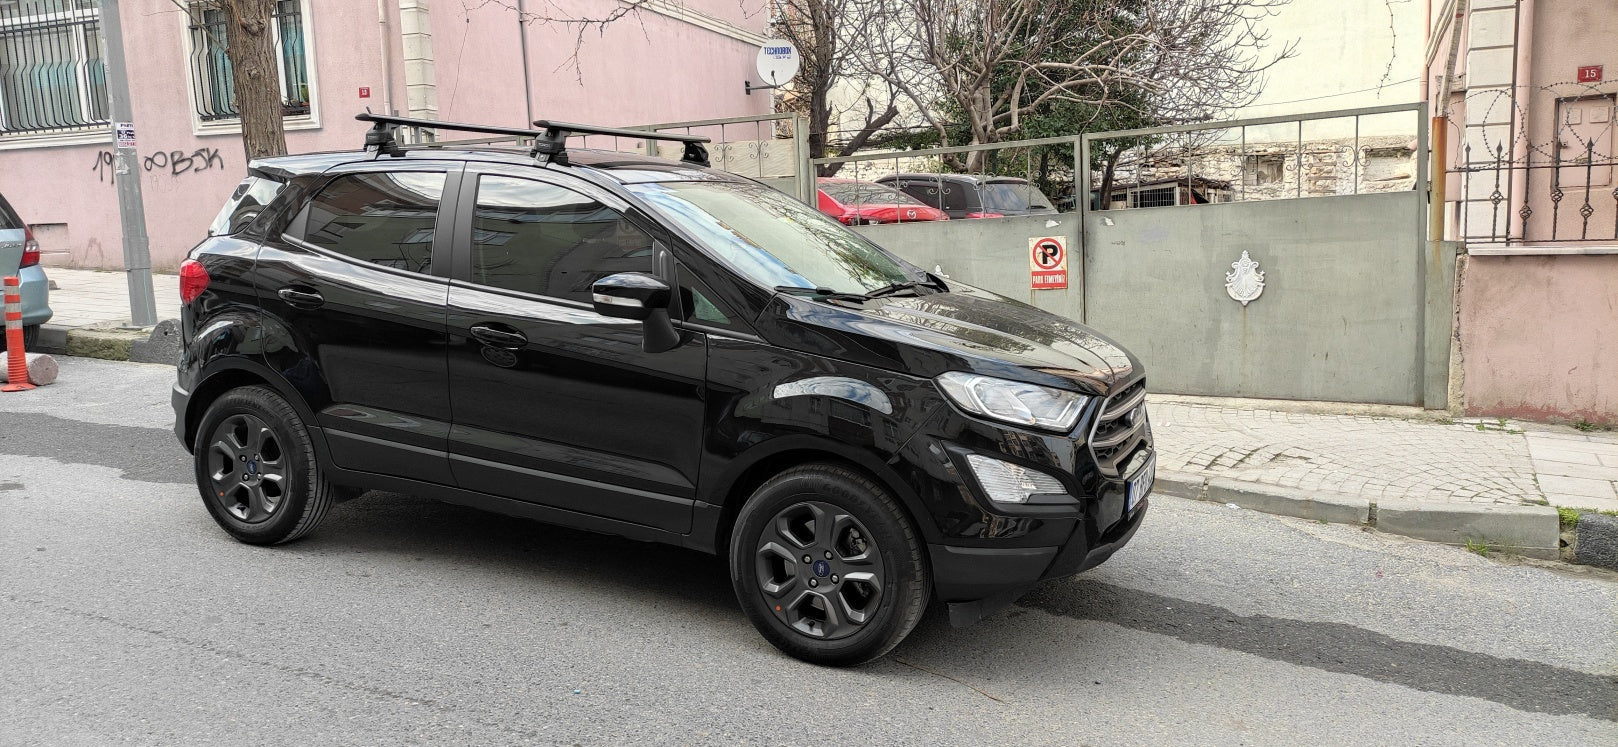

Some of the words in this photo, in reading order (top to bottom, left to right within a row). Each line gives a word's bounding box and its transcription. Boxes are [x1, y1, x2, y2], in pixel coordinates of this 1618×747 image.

[1585, 69, 1597, 78] 15
[170, 147, 224, 175] BJK
[1032, 275, 1043, 284] PARK
